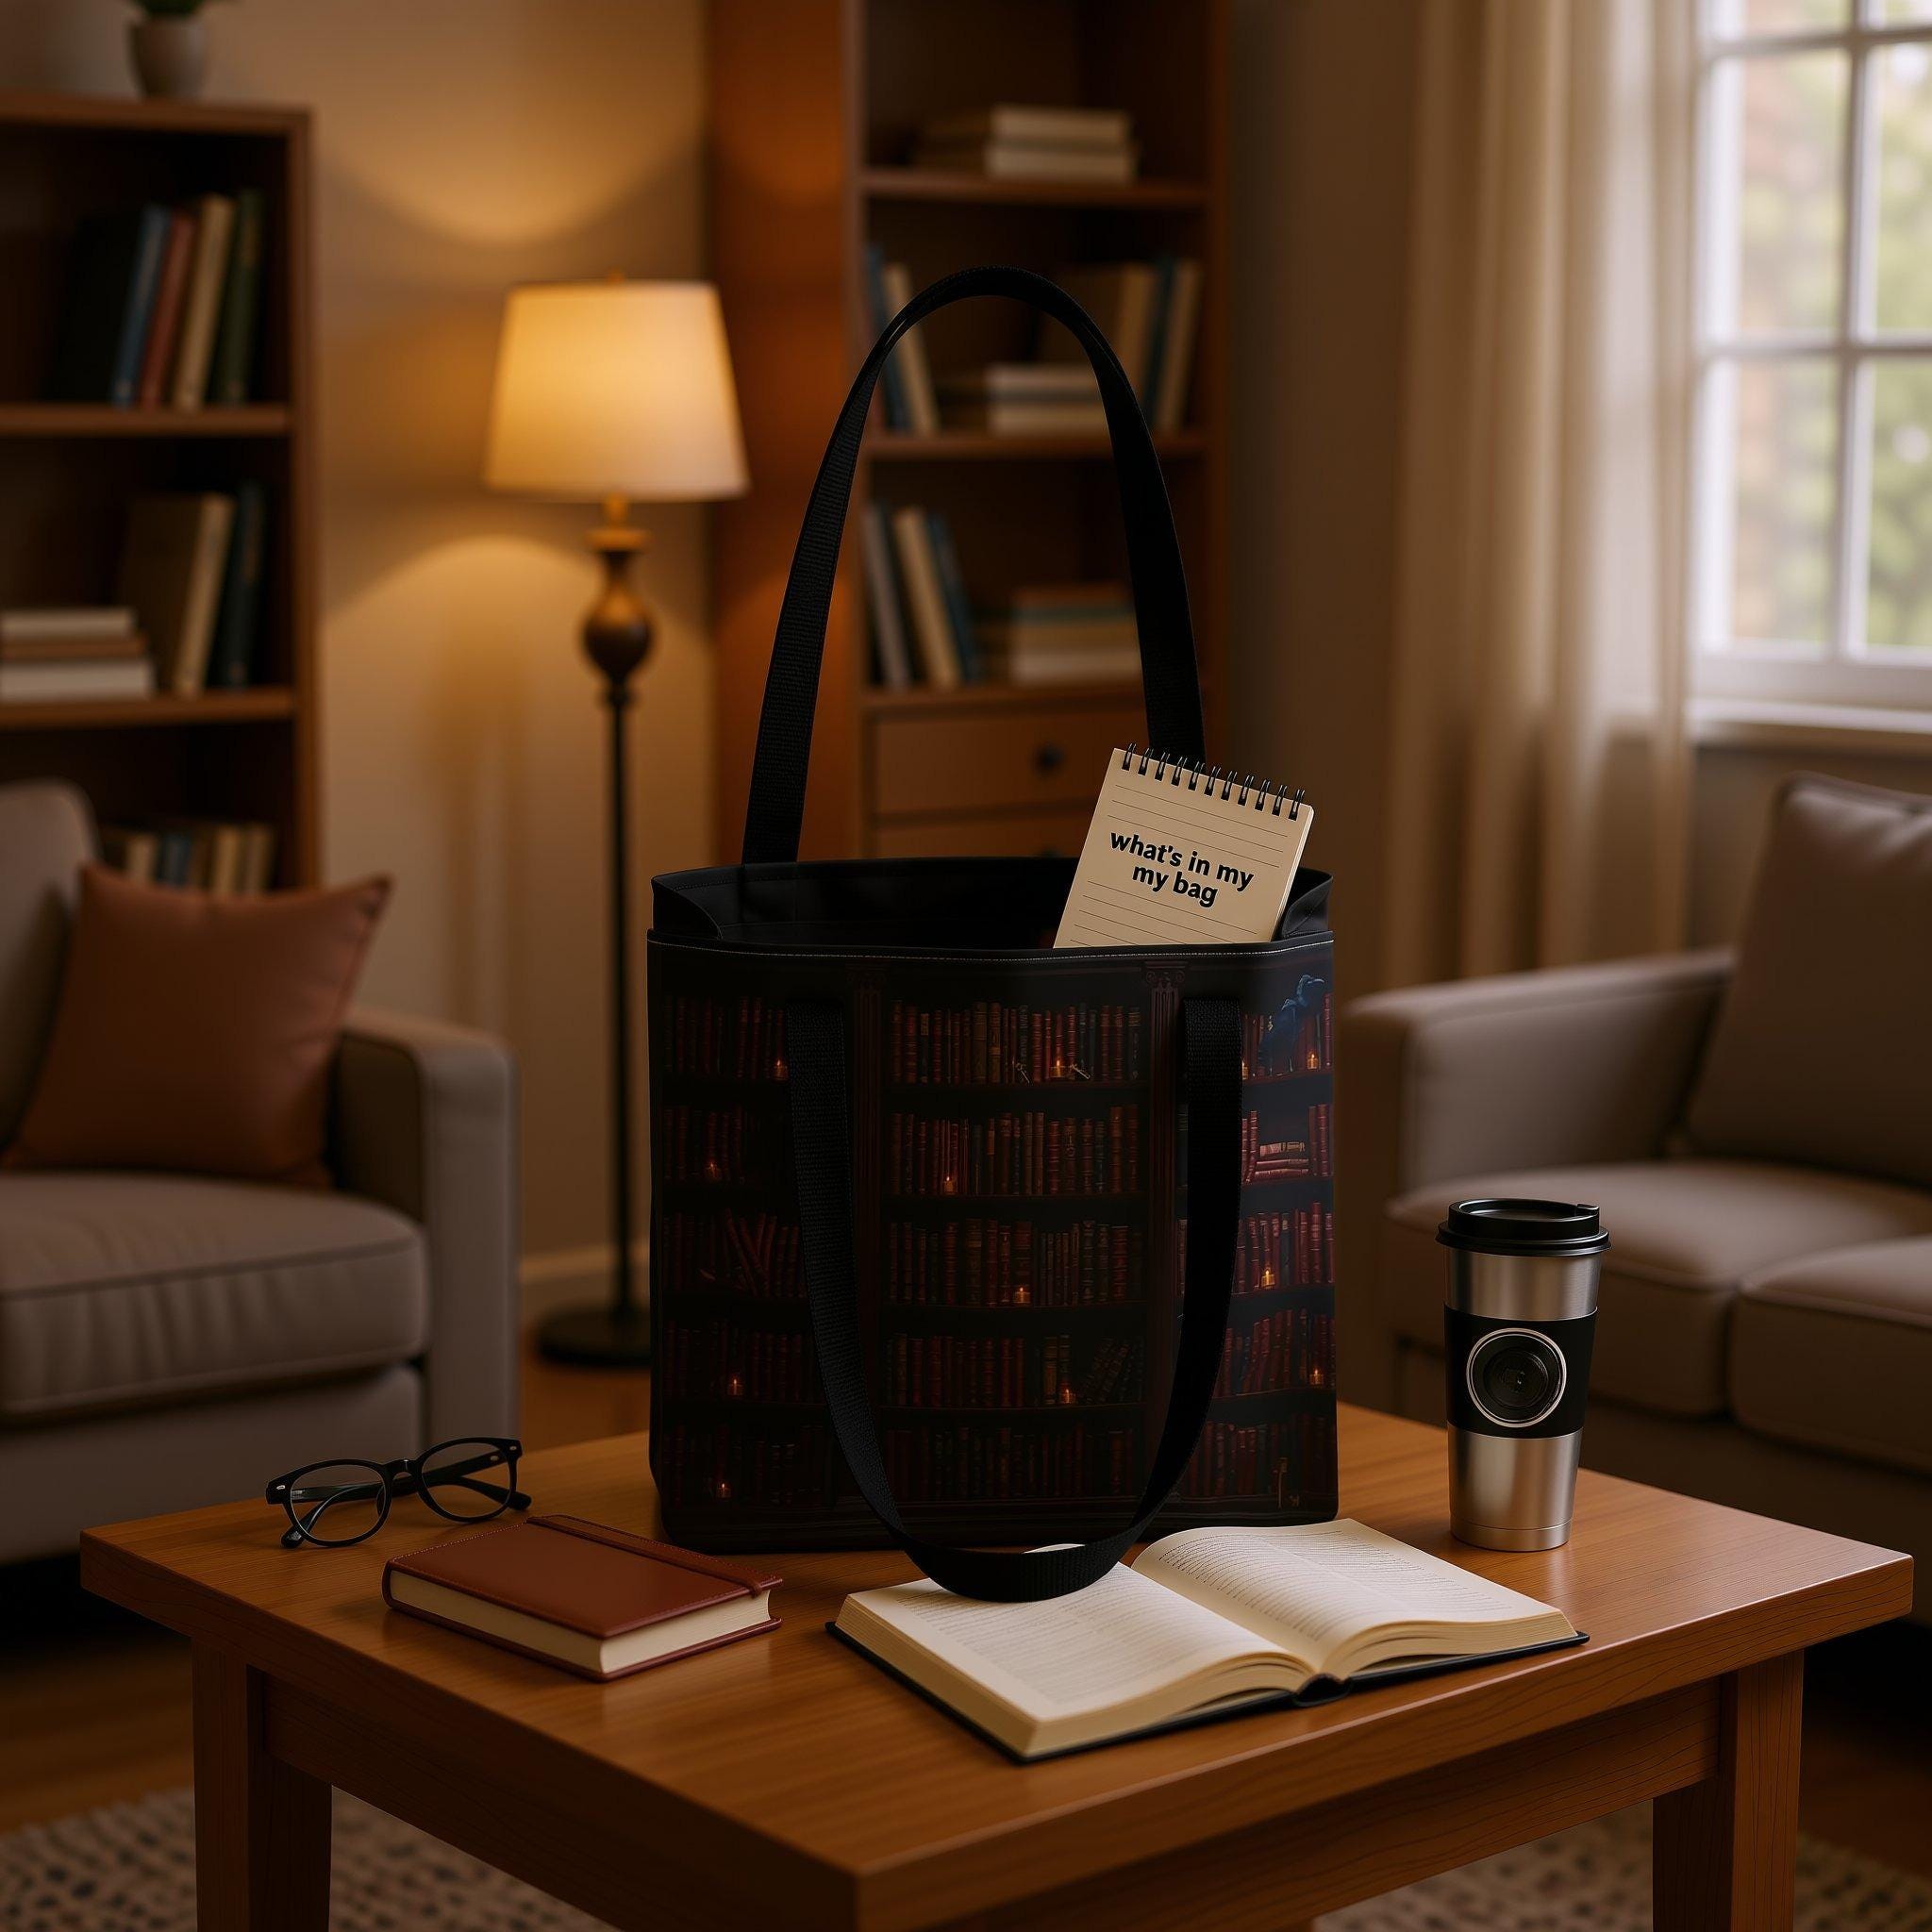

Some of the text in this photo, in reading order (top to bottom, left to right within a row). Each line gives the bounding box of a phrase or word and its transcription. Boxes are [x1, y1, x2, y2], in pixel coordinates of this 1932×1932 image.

[1110, 832, 1255, 892] what's in my
[1132, 866, 1219, 908] my bag
